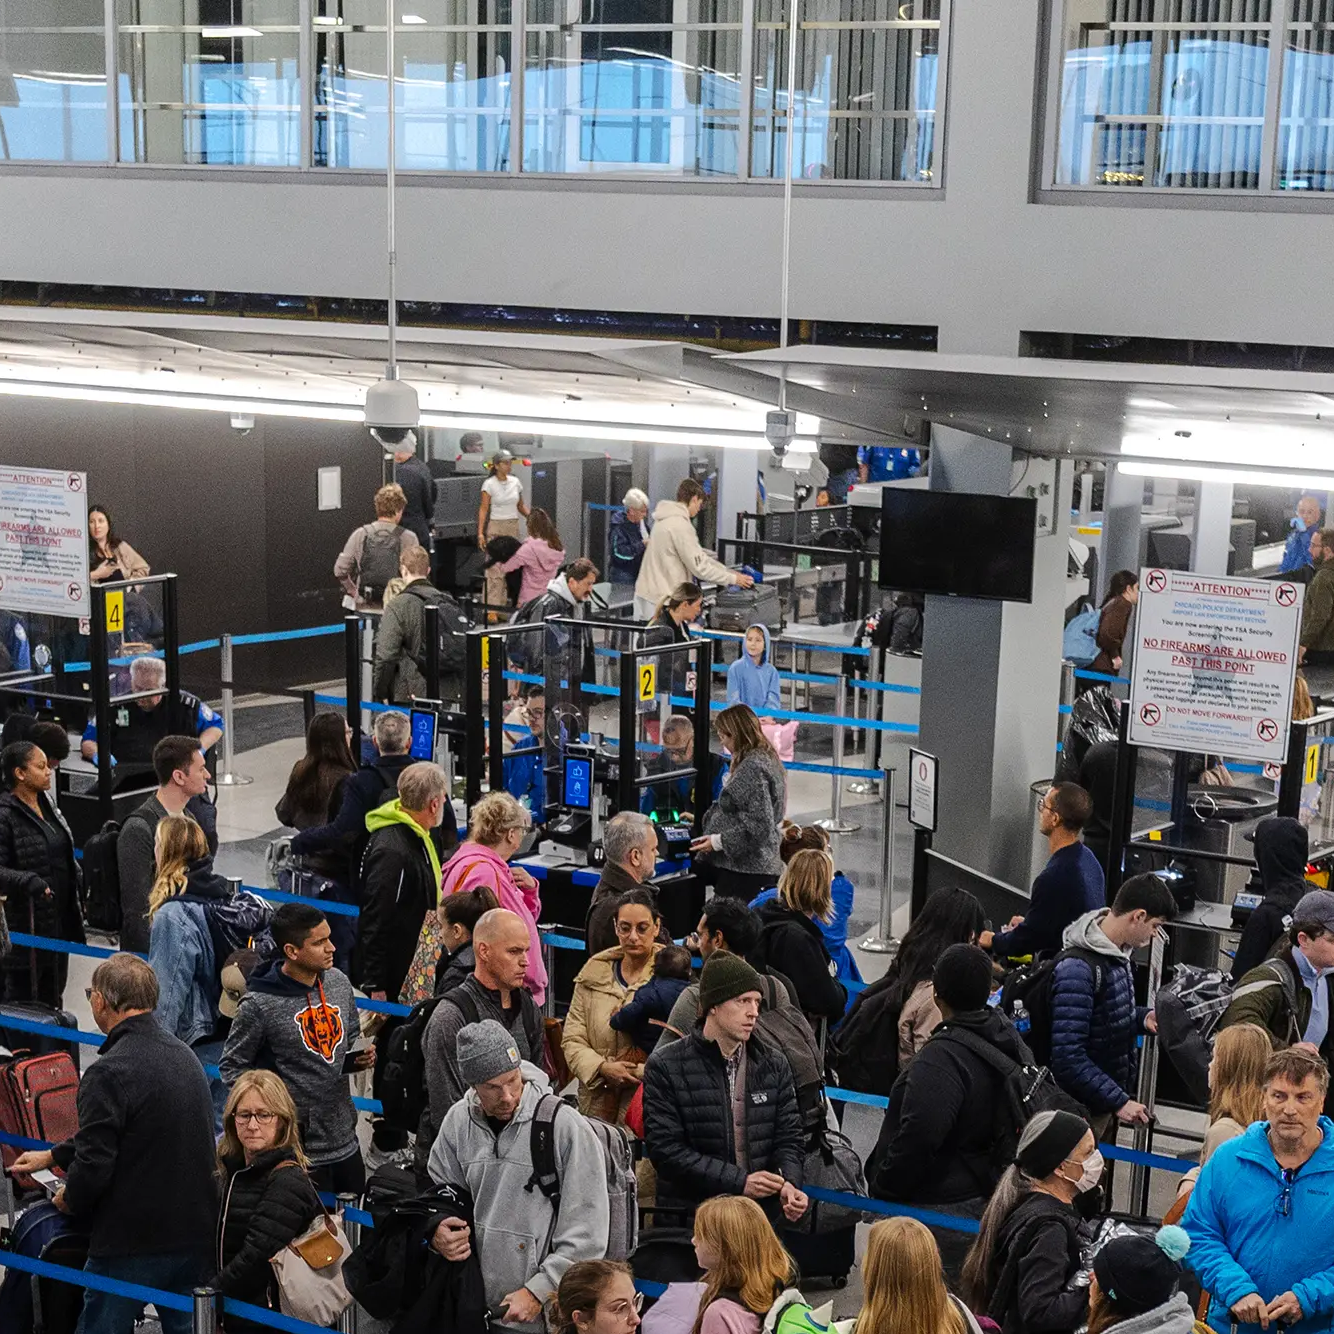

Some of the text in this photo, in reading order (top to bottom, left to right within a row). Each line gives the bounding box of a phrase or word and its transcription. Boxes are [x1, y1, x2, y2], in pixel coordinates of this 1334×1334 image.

[33, 526, 45, 534] ARE
[47, 527, 82, 537] ALLOWED
[5, 534, 62, 546] PAST THIS POINT
[1172, 609, 1193, 617] AIRPORT
[1174, 600, 1201, 610] CHICAGO
[1203, 604, 1224, 612] POLICE
[1225, 606, 1266, 616] DEPARTMENT
[110, 604, 120, 628] 4
[1188, 631, 1217, 640] Screening
[1199, 622, 1223, 632] entering
[1224, 624, 1234, 632] the
[1249, 628, 1273, 637] Security
[1143, 638, 1287, 662] NO FIREARMS ARE ALLOWED
[1172, 656, 1255, 673] PAST THIS POINT
[1157, 670, 1176, 678] firearm
[643, 669, 651, 696] 2
[1143, 677, 1164, 685] physical
[1150, 685, 1176, 693] passenger
[1166, 705, 1176, 713] DO
[1192, 709, 1210, 717] MOVE
[1310, 749, 1315, 778] 1
